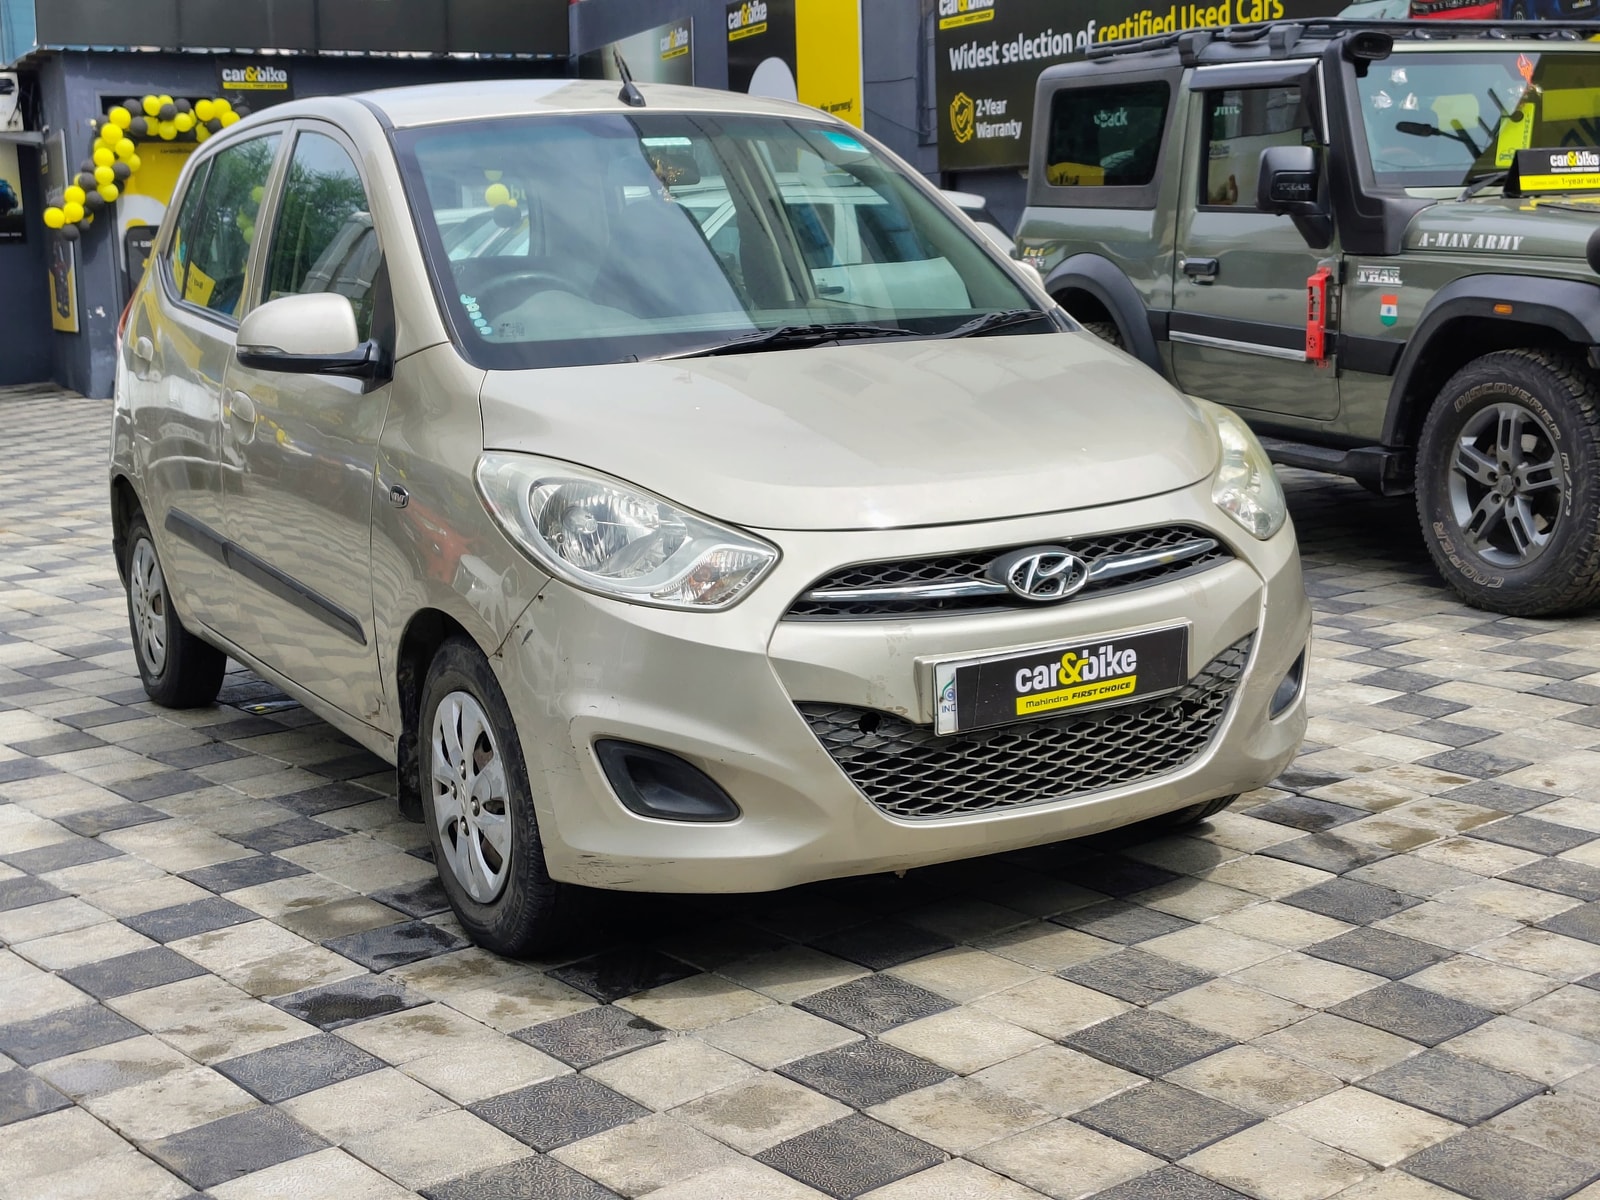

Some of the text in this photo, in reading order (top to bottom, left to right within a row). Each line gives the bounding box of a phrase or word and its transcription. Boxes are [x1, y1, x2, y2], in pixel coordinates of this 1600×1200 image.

[728, 0, 767, 30] car&bike
[660, 27, 688, 51] car&bike
[949, 0, 1284, 71] Widest selection of certified Used Cars
[222, 66, 287, 82] car&bike
[975, 99, 1007, 117] 2-Year
[976, 119, 1022, 139] Warranty
[1550, 150, 1600, 167] car&bike
[1418, 232, 1524, 250] A-MAN ARMY
[1454, 382, 1561, 441] DISCOVERER
[1432, 521, 1504, 589] COOPER
[1015, 644, 1137, 693] car&bike
[1025, 681, 1131, 709] Mahindra FIRST CHOICE
